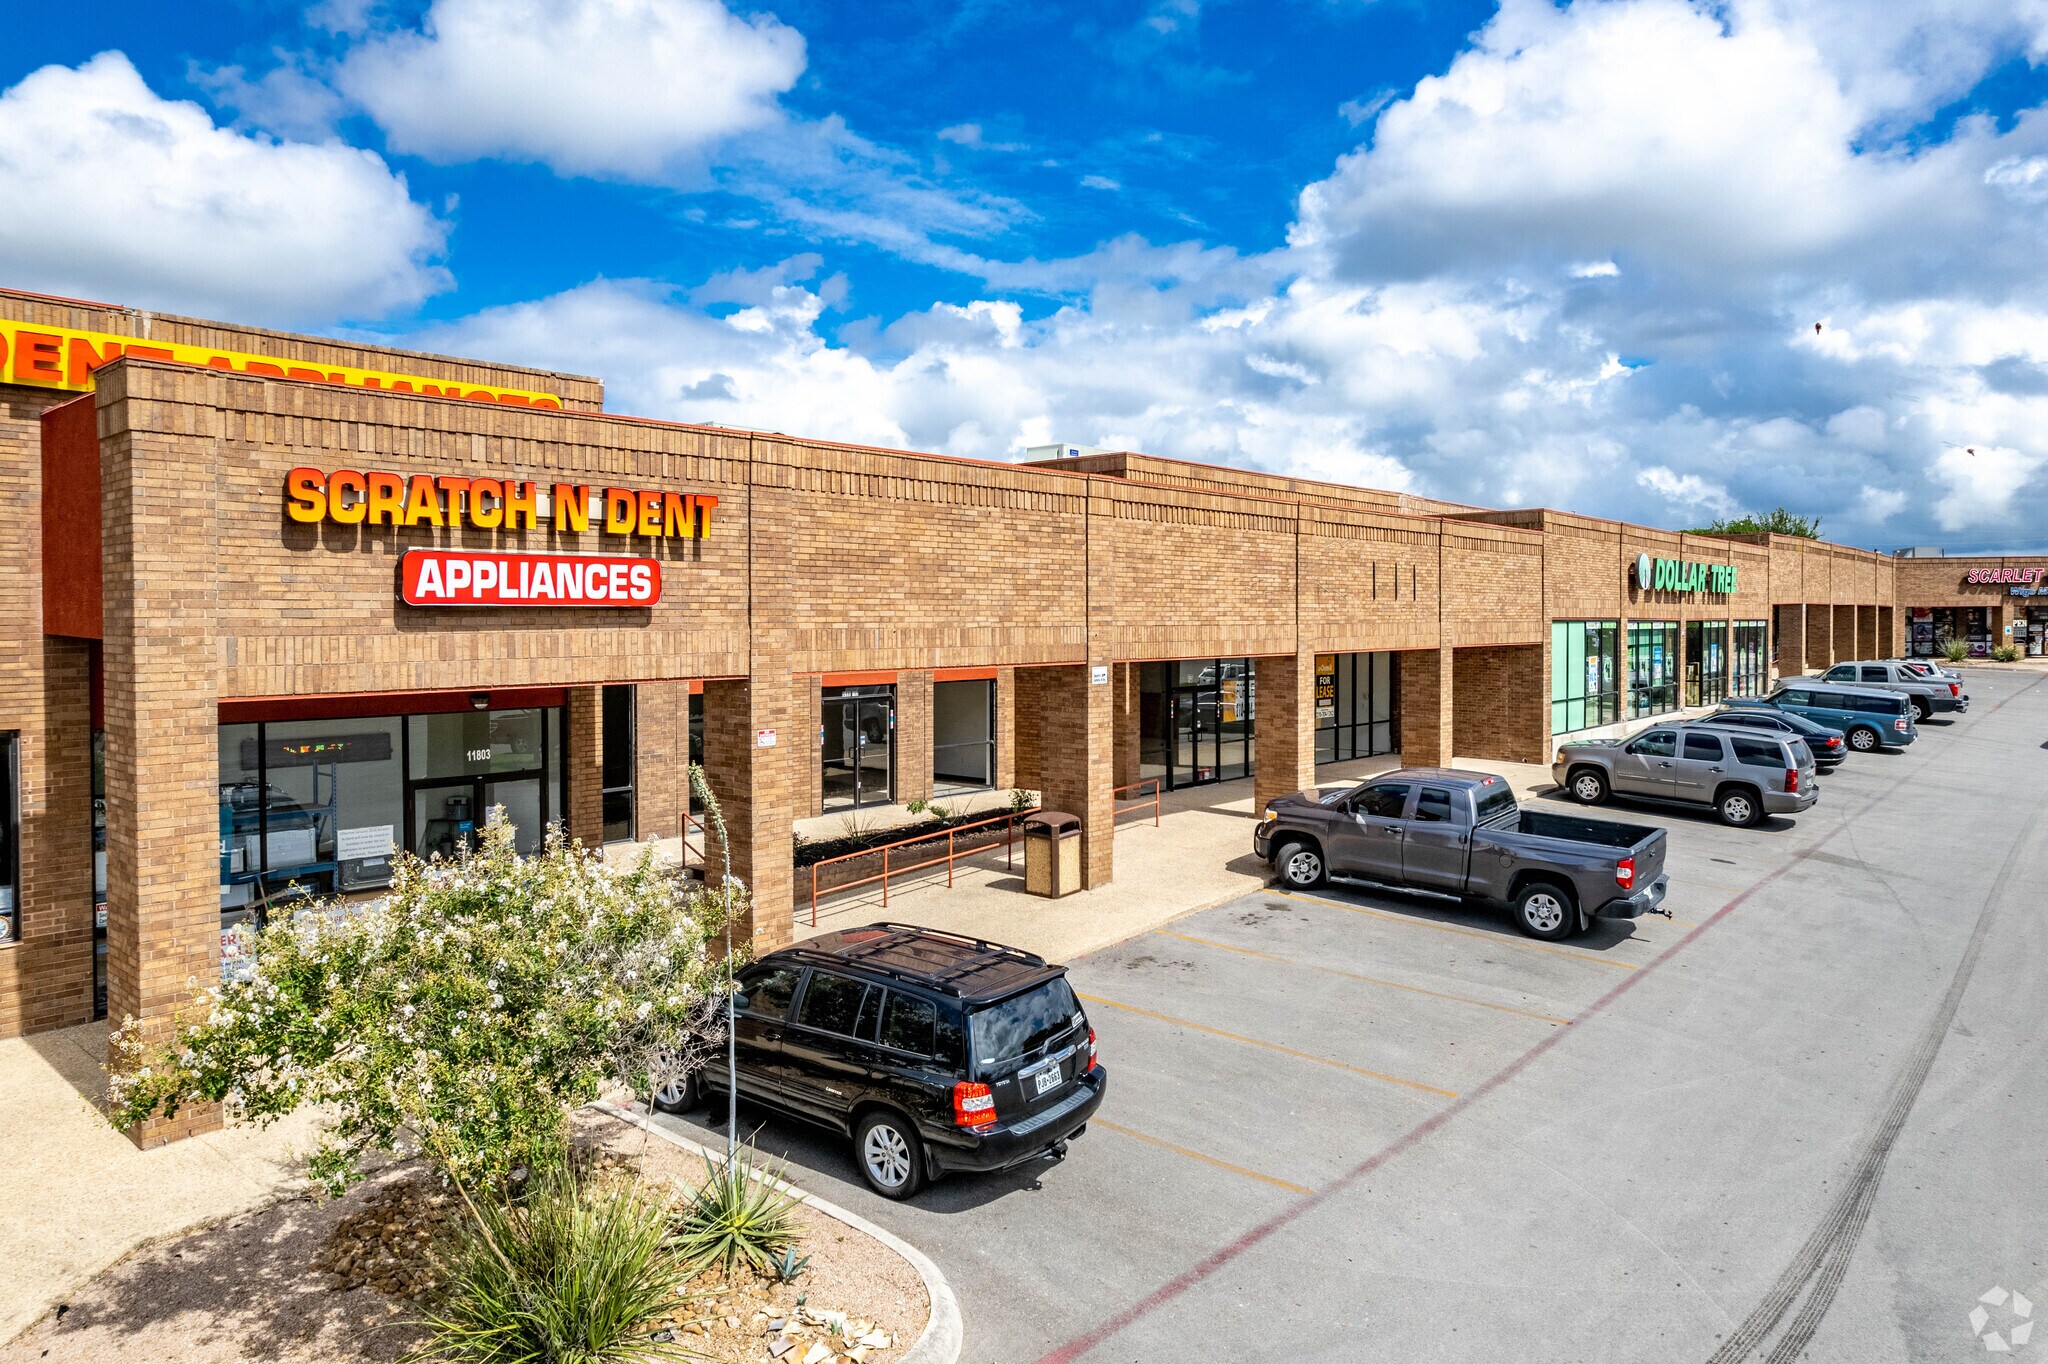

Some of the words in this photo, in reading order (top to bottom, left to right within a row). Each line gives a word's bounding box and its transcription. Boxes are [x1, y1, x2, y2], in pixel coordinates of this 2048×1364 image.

[0, 330, 174, 385] EN
[286, 467, 537, 530] SCRATCH
[551, 484, 589, 532] N
[603, 487, 719, 539] DENT
[416, 558, 652, 600] APPLIANCES
[1653, 558, 1706, 591] DOLLAR
[1709, 564, 1738, 593] TREE
[1968, 568, 2045, 583] SCARLET
[1316, 685, 1334, 698] LEASE
[1320, 676, 1330, 685] FOR
[467, 749, 491, 761] 11803
